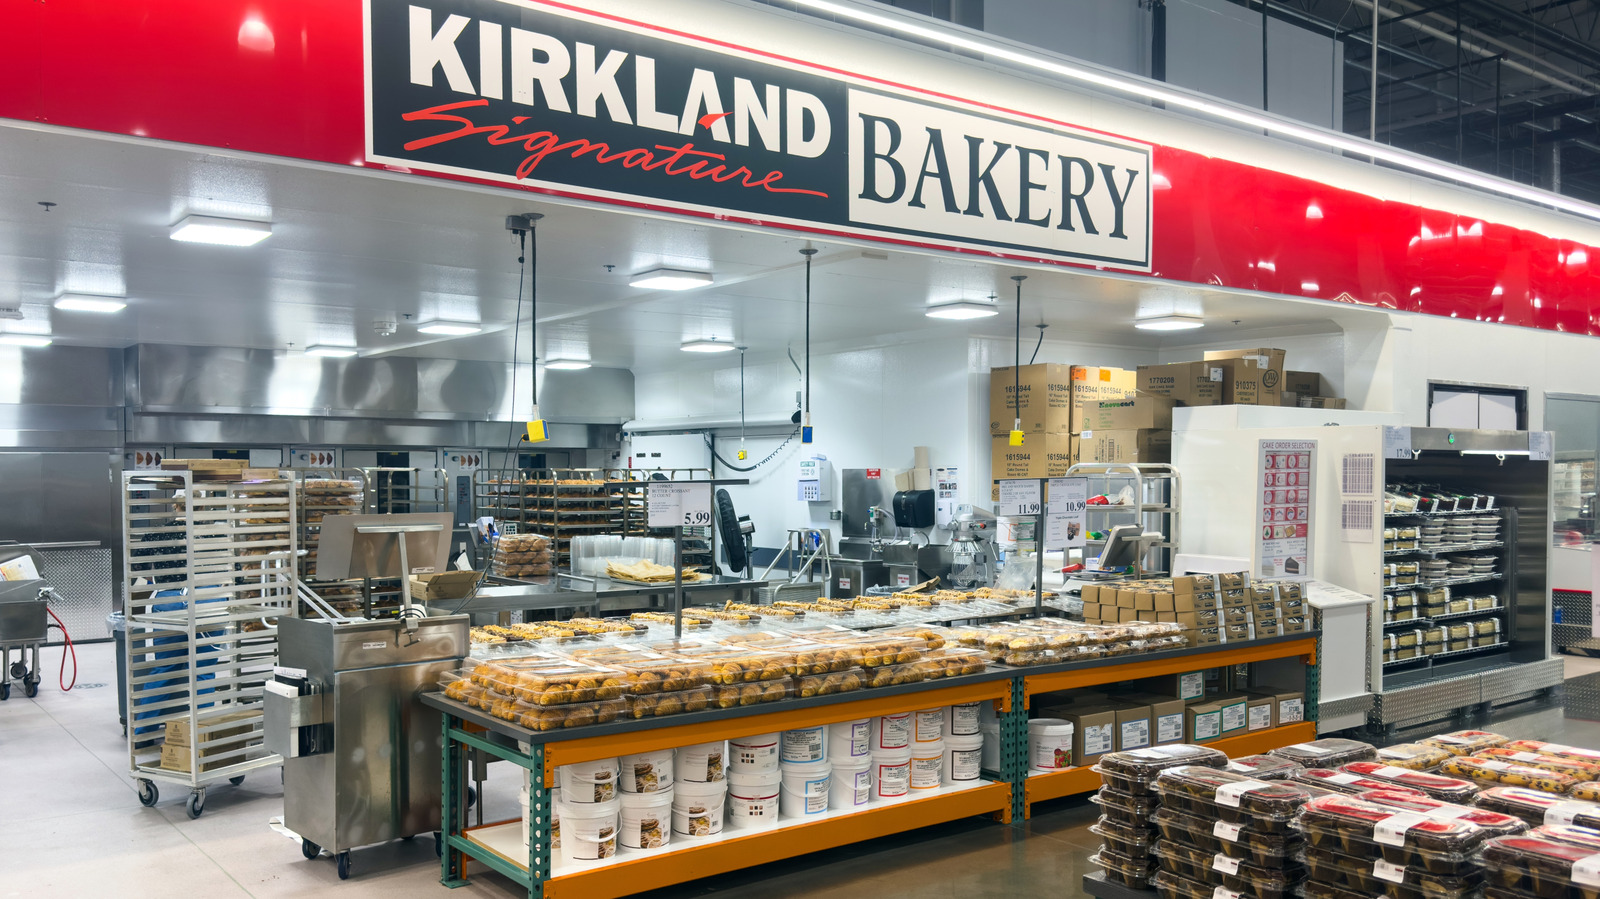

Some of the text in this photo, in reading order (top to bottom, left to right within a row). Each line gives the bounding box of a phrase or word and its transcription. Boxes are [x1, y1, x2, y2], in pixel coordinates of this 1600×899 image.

[409, 5, 833, 158] KIRKLAND
[402, 99, 828, 198] Signature
[858, 112, 1139, 240] BAKERY
[1005, 384, 1031, 393] 161944
[1047, 384, 1070, 392] 1615944
[1074, 385, 1098, 393] 1615944
[1235, 381, 1256, 390] 910375
[1291, 442, 1315, 450] SELECTION
[1006, 453, 1031, 461] 1615944
[1047, 453, 1069, 461] 1615944
[1396, 449, 1411, 458] 17.99
[1019, 503, 1040, 514] 11.99
[1066, 502, 1086, 512] 10.99
[684, 512, 710, 525] 5.99
